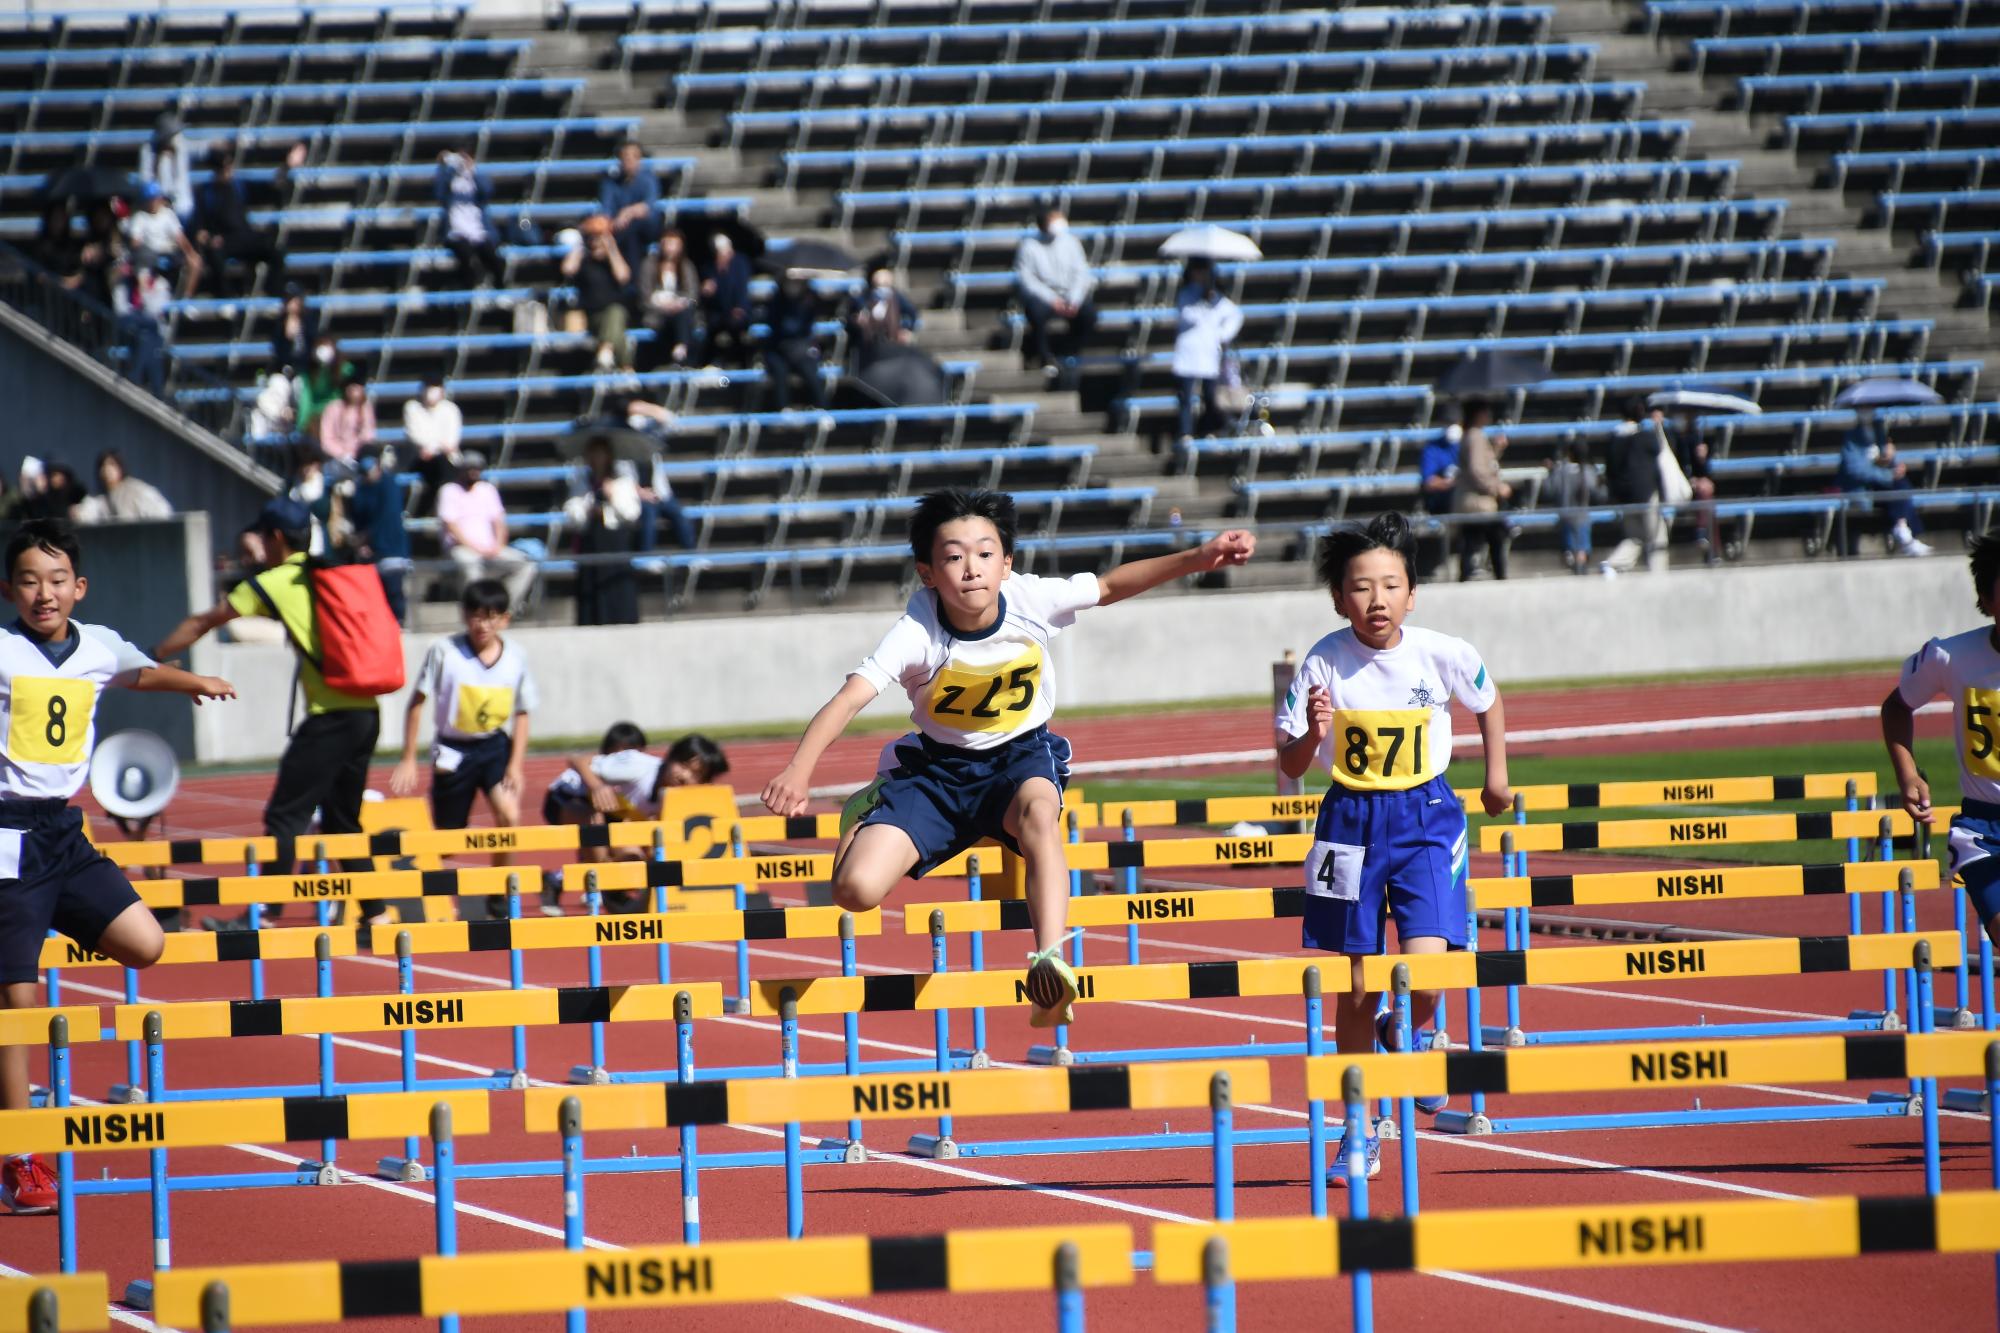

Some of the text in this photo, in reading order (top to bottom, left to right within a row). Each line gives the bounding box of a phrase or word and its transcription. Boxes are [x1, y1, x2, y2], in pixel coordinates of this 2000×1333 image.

[46, 695, 66, 747] 8
[476, 697, 491, 725] 6
[1967, 705, 2000, 759] 5
[1345, 724, 1423, 777] 871
[1663, 784, 1714, 800] NISHI
[465, 833, 516, 849] NISHI
[1669, 822, 1726, 840] NISHI
[1216, 842, 1273, 859] NISHI
[756, 860, 814, 878] NISHI
[1317, 849, 1336, 890] 4
[294, 874, 350, 896] NISHI
[1657, 875, 1723, 897] NISHI
[1128, 898, 1193, 919] NISHI
[596, 920, 662, 941] NISHI
[1627, 949, 1704, 975] NISHI
[384, 999, 463, 1025] NISHI
[1632, 1051, 1727, 1081] NISHI
[854, 1082, 950, 1112] NISHI
[65, 1113, 164, 1145] NISHI
[1579, 1217, 1703, 1255] NISHI
[587, 1259, 711, 1297] NISHI
